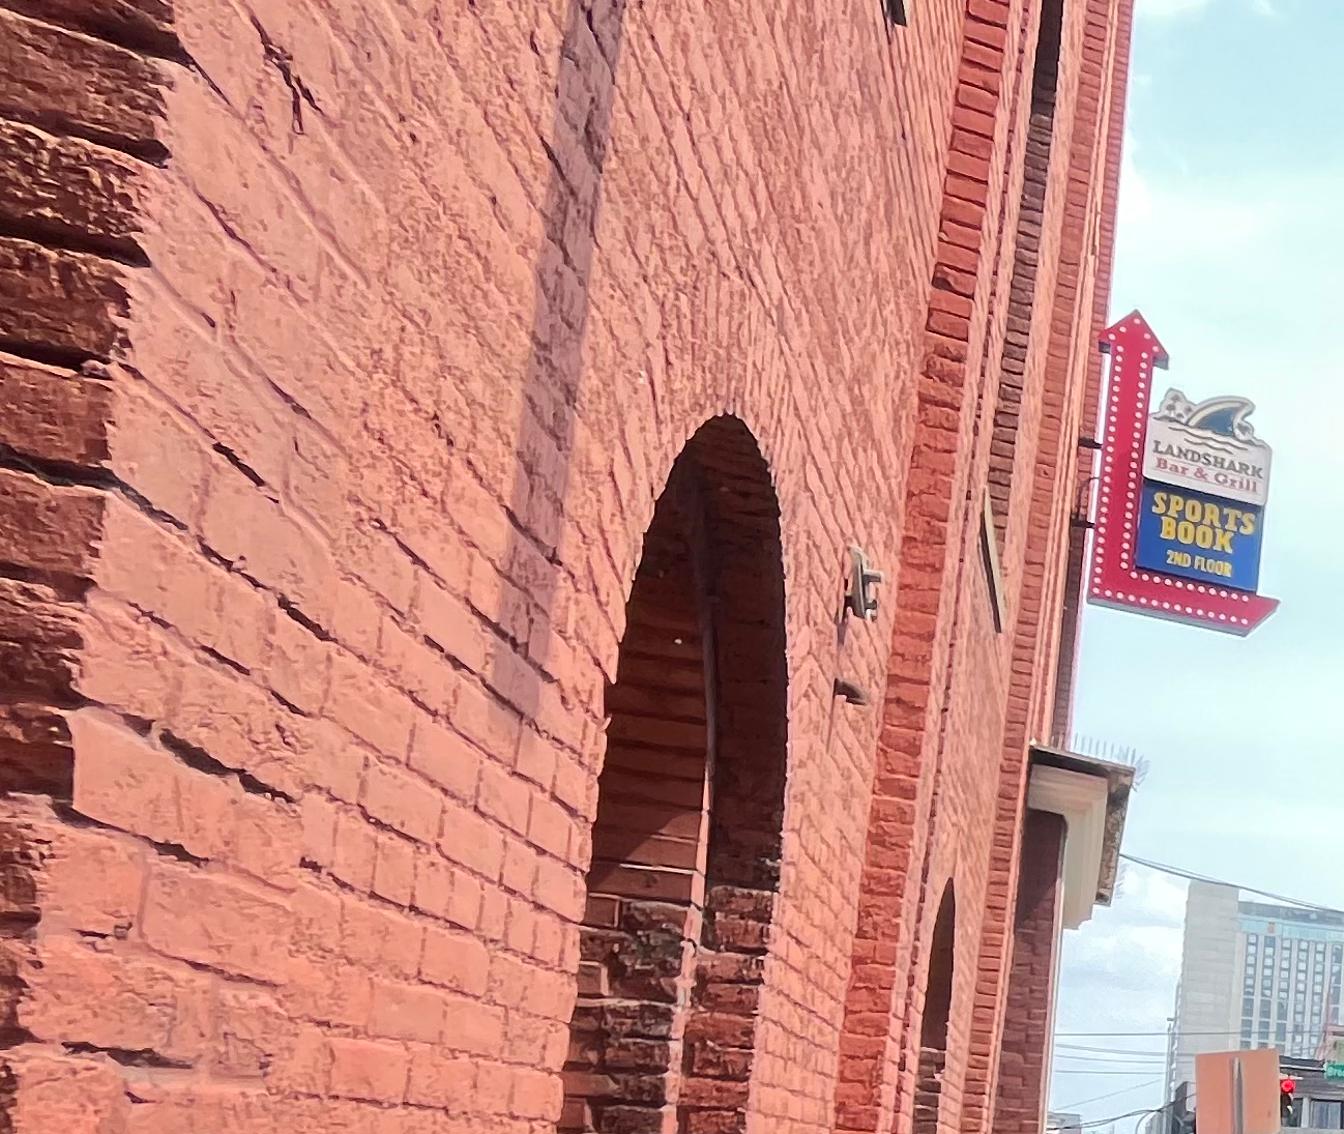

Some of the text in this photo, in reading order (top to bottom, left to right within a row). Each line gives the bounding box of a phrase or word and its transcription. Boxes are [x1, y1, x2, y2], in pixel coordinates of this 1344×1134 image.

[1152, 439, 1263, 479] LANDSHARK
[1155, 456, 1257, 493] Bar & Grill
[1152, 491, 1256, 536] SPORTS
[1160, 515, 1235, 554] BOOK
[1166, 549, 1233, 578] 2ND FLOOR
